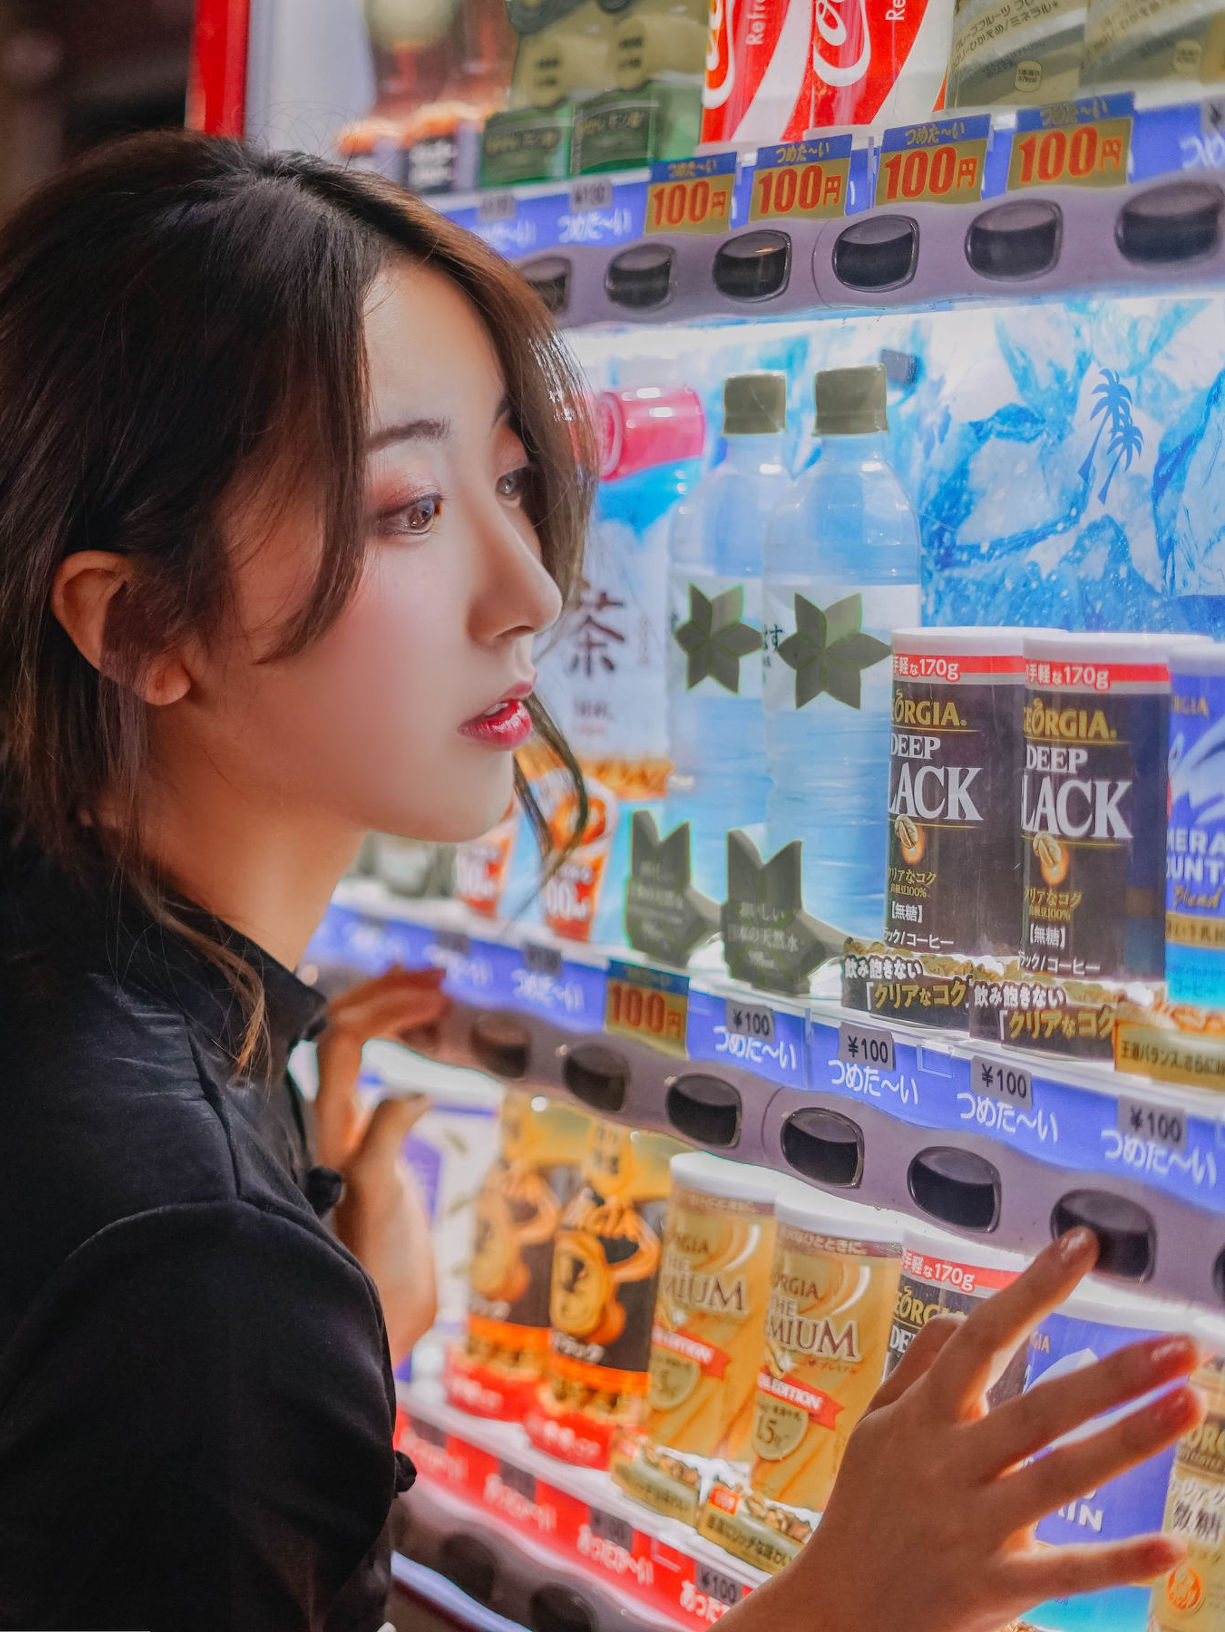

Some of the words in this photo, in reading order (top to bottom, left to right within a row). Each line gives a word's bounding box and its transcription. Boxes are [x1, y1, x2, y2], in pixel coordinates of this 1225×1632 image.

[745, 0, 767, 45] Refr
[883, 145, 979, 201] 100円
[1017, 125, 1124, 185] 100円
[653, 180, 728, 227] 100円
[757, 164, 842, 215] 100円
[891, 732, 941, 760] DEEP
[1026, 744, 1089, 774] DEEP
[733, 1008, 771, 1037] ¥100
[847, 1034, 889, 1064] ¥100
[981, 1063, 1027, 1099] ¥100
[1129, 1106, 1183, 1143] ¥100
[889, 1325, 916, 1354] DE
